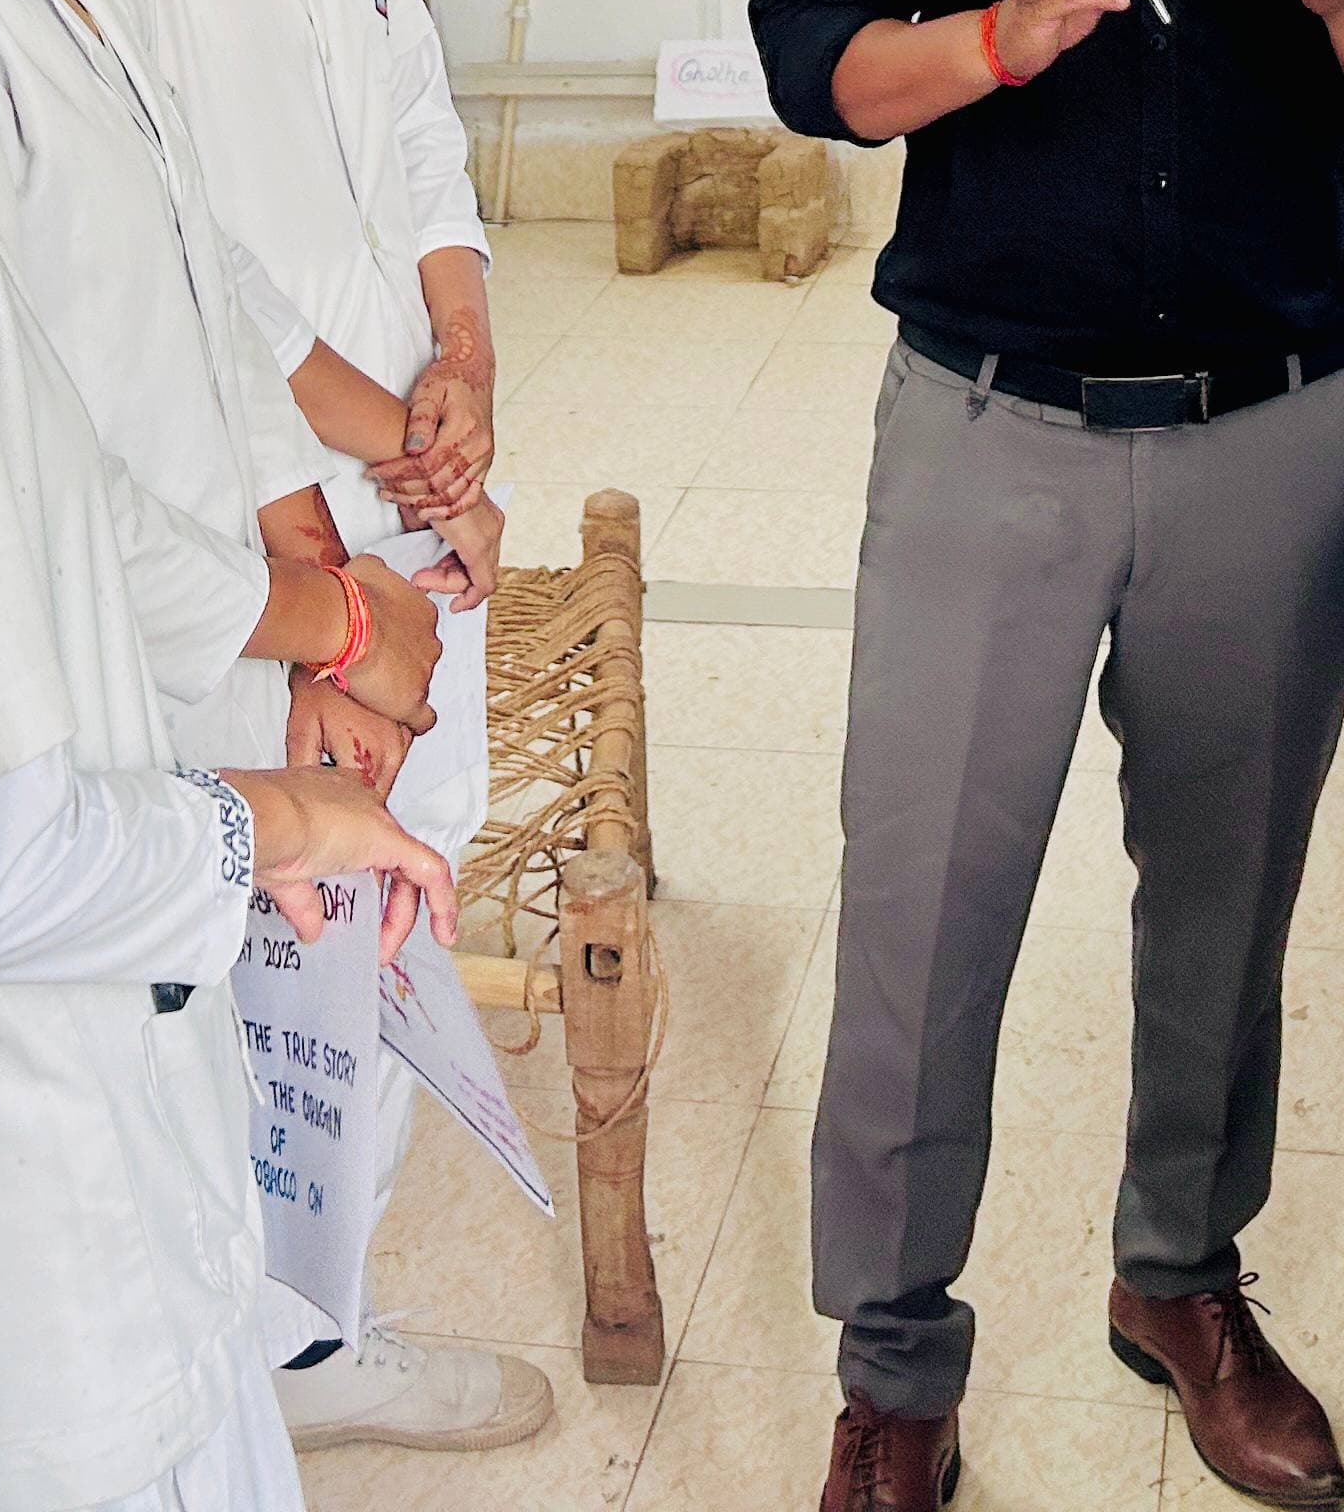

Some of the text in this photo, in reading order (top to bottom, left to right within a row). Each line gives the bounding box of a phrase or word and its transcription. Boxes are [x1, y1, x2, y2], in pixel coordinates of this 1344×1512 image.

[317, 882, 356, 924] DAY
[263, 936, 301, 970] 2025
[243, 1020, 357, 1088] THE TRUE STORY
[268, 1081, 296, 1113] THE
[270, 1125, 286, 1156] OF
